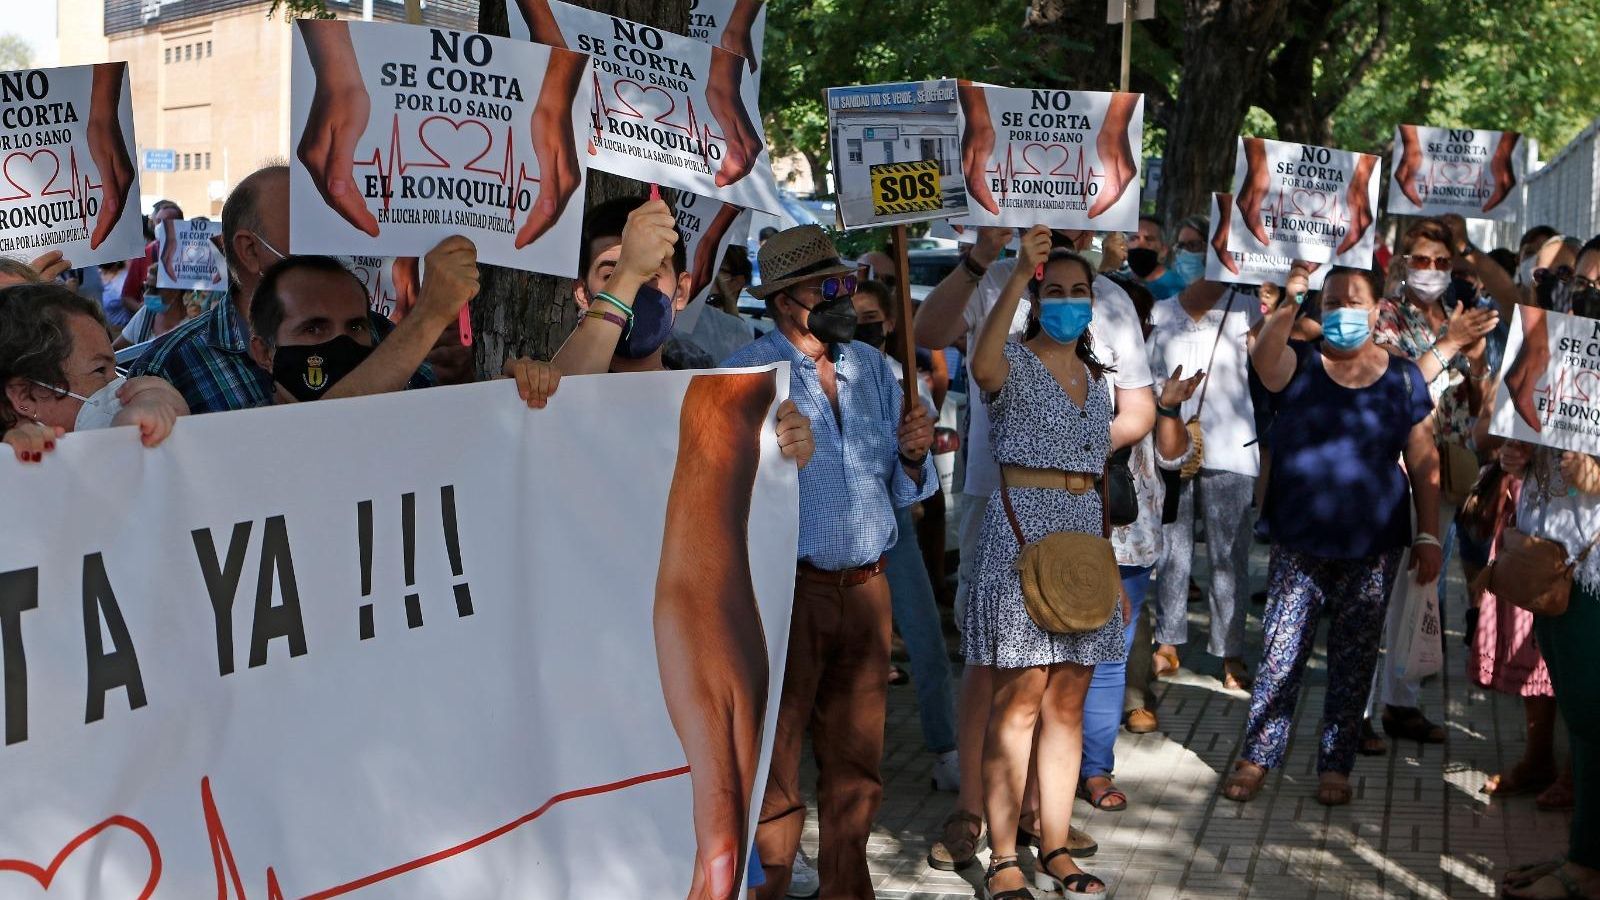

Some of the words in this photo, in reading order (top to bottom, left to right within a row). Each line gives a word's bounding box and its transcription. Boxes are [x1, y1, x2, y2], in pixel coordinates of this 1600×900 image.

[610, 17, 664, 51] NO
[430, 28, 493, 67] NO
[577, 33, 607, 57] SE
[613, 44, 697, 81] CORTA
[380, 62, 418, 88] SE
[426, 66, 524, 102] CORTA
[592, 57, 623, 76] POR
[626, 65, 645, 82] LO
[649, 71, 689, 93] SANO
[0, 70, 49, 103] NO
[394, 92, 434, 112] POR
[438, 96, 462, 114] LO
[466, 100, 513, 122] SANO
[841, 94, 870, 109] SANIDAD
[871, 92, 881, 106] NO
[882, 92, 892, 105] SE
[1031, 89, 1071, 111] NO
[2, 101, 79, 129] CORTA
[1001, 111, 1023, 127] SE
[1028, 113, 1091, 130] CORTA
[14, 132, 32, 149] LO
[35, 128, 72, 147] SANO
[606, 116, 721, 161] RONQUILLO
[1009, 130, 1032, 141] POR
[1035, 131, 1050, 142] LO
[1052, 132, 1083, 143] SANO
[1448, 129, 1475, 143] NO
[603, 138, 628, 155] LUCHA
[628, 144, 642, 158] POR
[642, 148, 653, 160] LA
[652, 150, 684, 168] SANIDAD
[1300, 145, 1331, 165] NO
[1427, 142, 1442, 153] SE
[1446, 143, 1488, 156] CORTA
[1276, 161, 1294, 175] SE
[1297, 164, 1344, 182] CORTA
[364, 174, 395, 199] EL
[401, 175, 532, 212] RONQUILLO
[880, 172, 936, 202] SOS
[991, 178, 1008, 193] EL
[1012, 179, 1098, 198] RONQUILLO
[1282, 177, 1300, 188] POR
[1302, 179, 1313, 190] LO
[1315, 181, 1338, 193] SANO
[1418, 184, 1429, 195] EL
[1432, 185, 1490, 199] RONQUILLO
[0, 196, 98, 231] RONQUILLO
[1006, 198, 1023, 208] LUCHA
[1023, 199, 1035, 209] POR
[1042, 199, 1065, 210] SANIDAD
[190, 220, 207, 231] NO
[377, 208, 390, 223] EN
[391, 208, 421, 224] LUCHA
[422, 209, 441, 224] POR
[442, 209, 454, 225] LA
[454, 209, 487, 229] SANIDAD
[675, 208, 701, 233] RTA
[1264, 215, 1278, 229] EL
[1281, 217, 1346, 238] RONQUILLO
[16, 235, 31, 249] POR
[31, 233, 41, 248] LA
[40, 230, 66, 247] SANIDAD
[179, 232, 188, 240] SE
[182, 264, 218, 274] RONQUILLO
[1559, 337, 1581, 353] SE
[1565, 355, 1588, 368] POR
[1538, 397, 1555, 413] EL
[190, 514, 308, 677] YA
